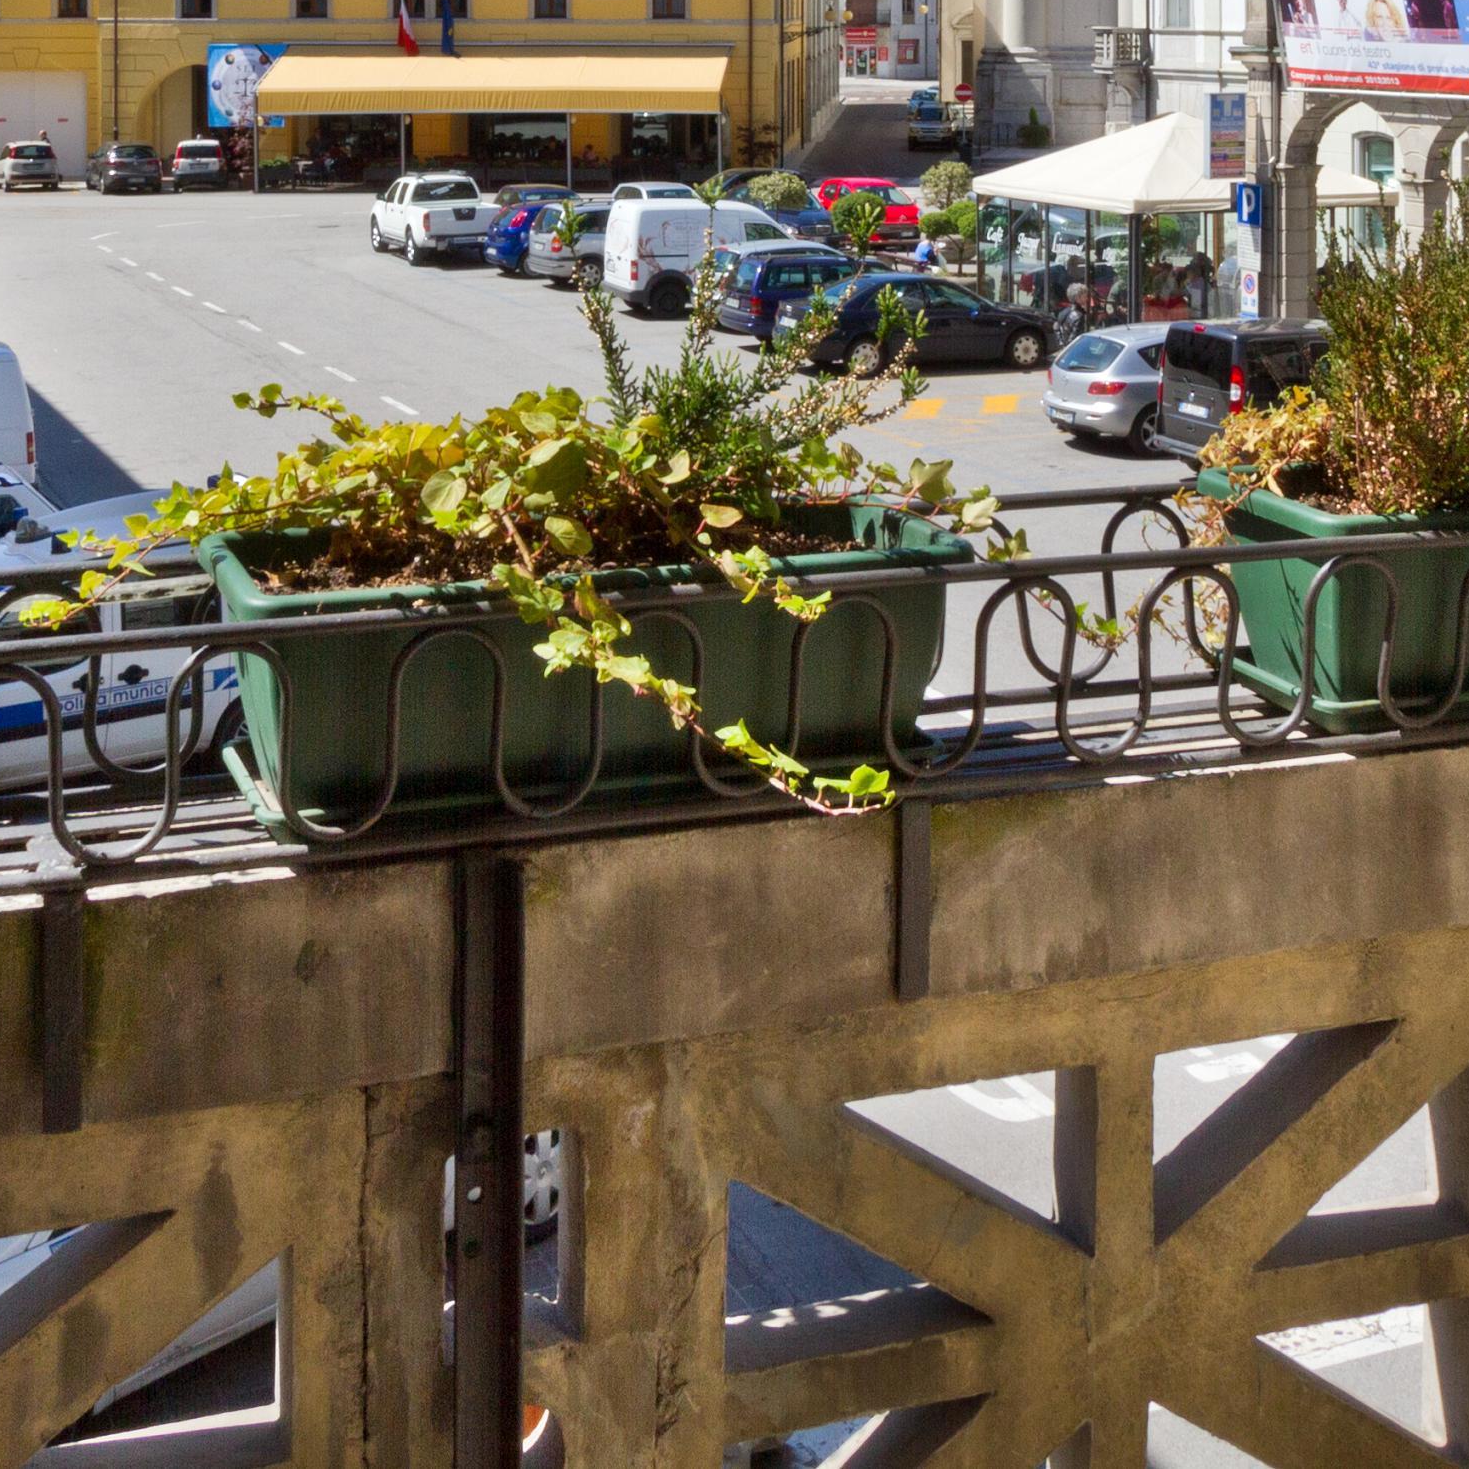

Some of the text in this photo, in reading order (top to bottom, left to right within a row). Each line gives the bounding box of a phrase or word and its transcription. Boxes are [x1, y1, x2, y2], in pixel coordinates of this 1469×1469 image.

[1322, 45, 1347, 57] cuore
[1348, 43, 1362, 57] del
[1363, 44, 1392, 58] teatro
